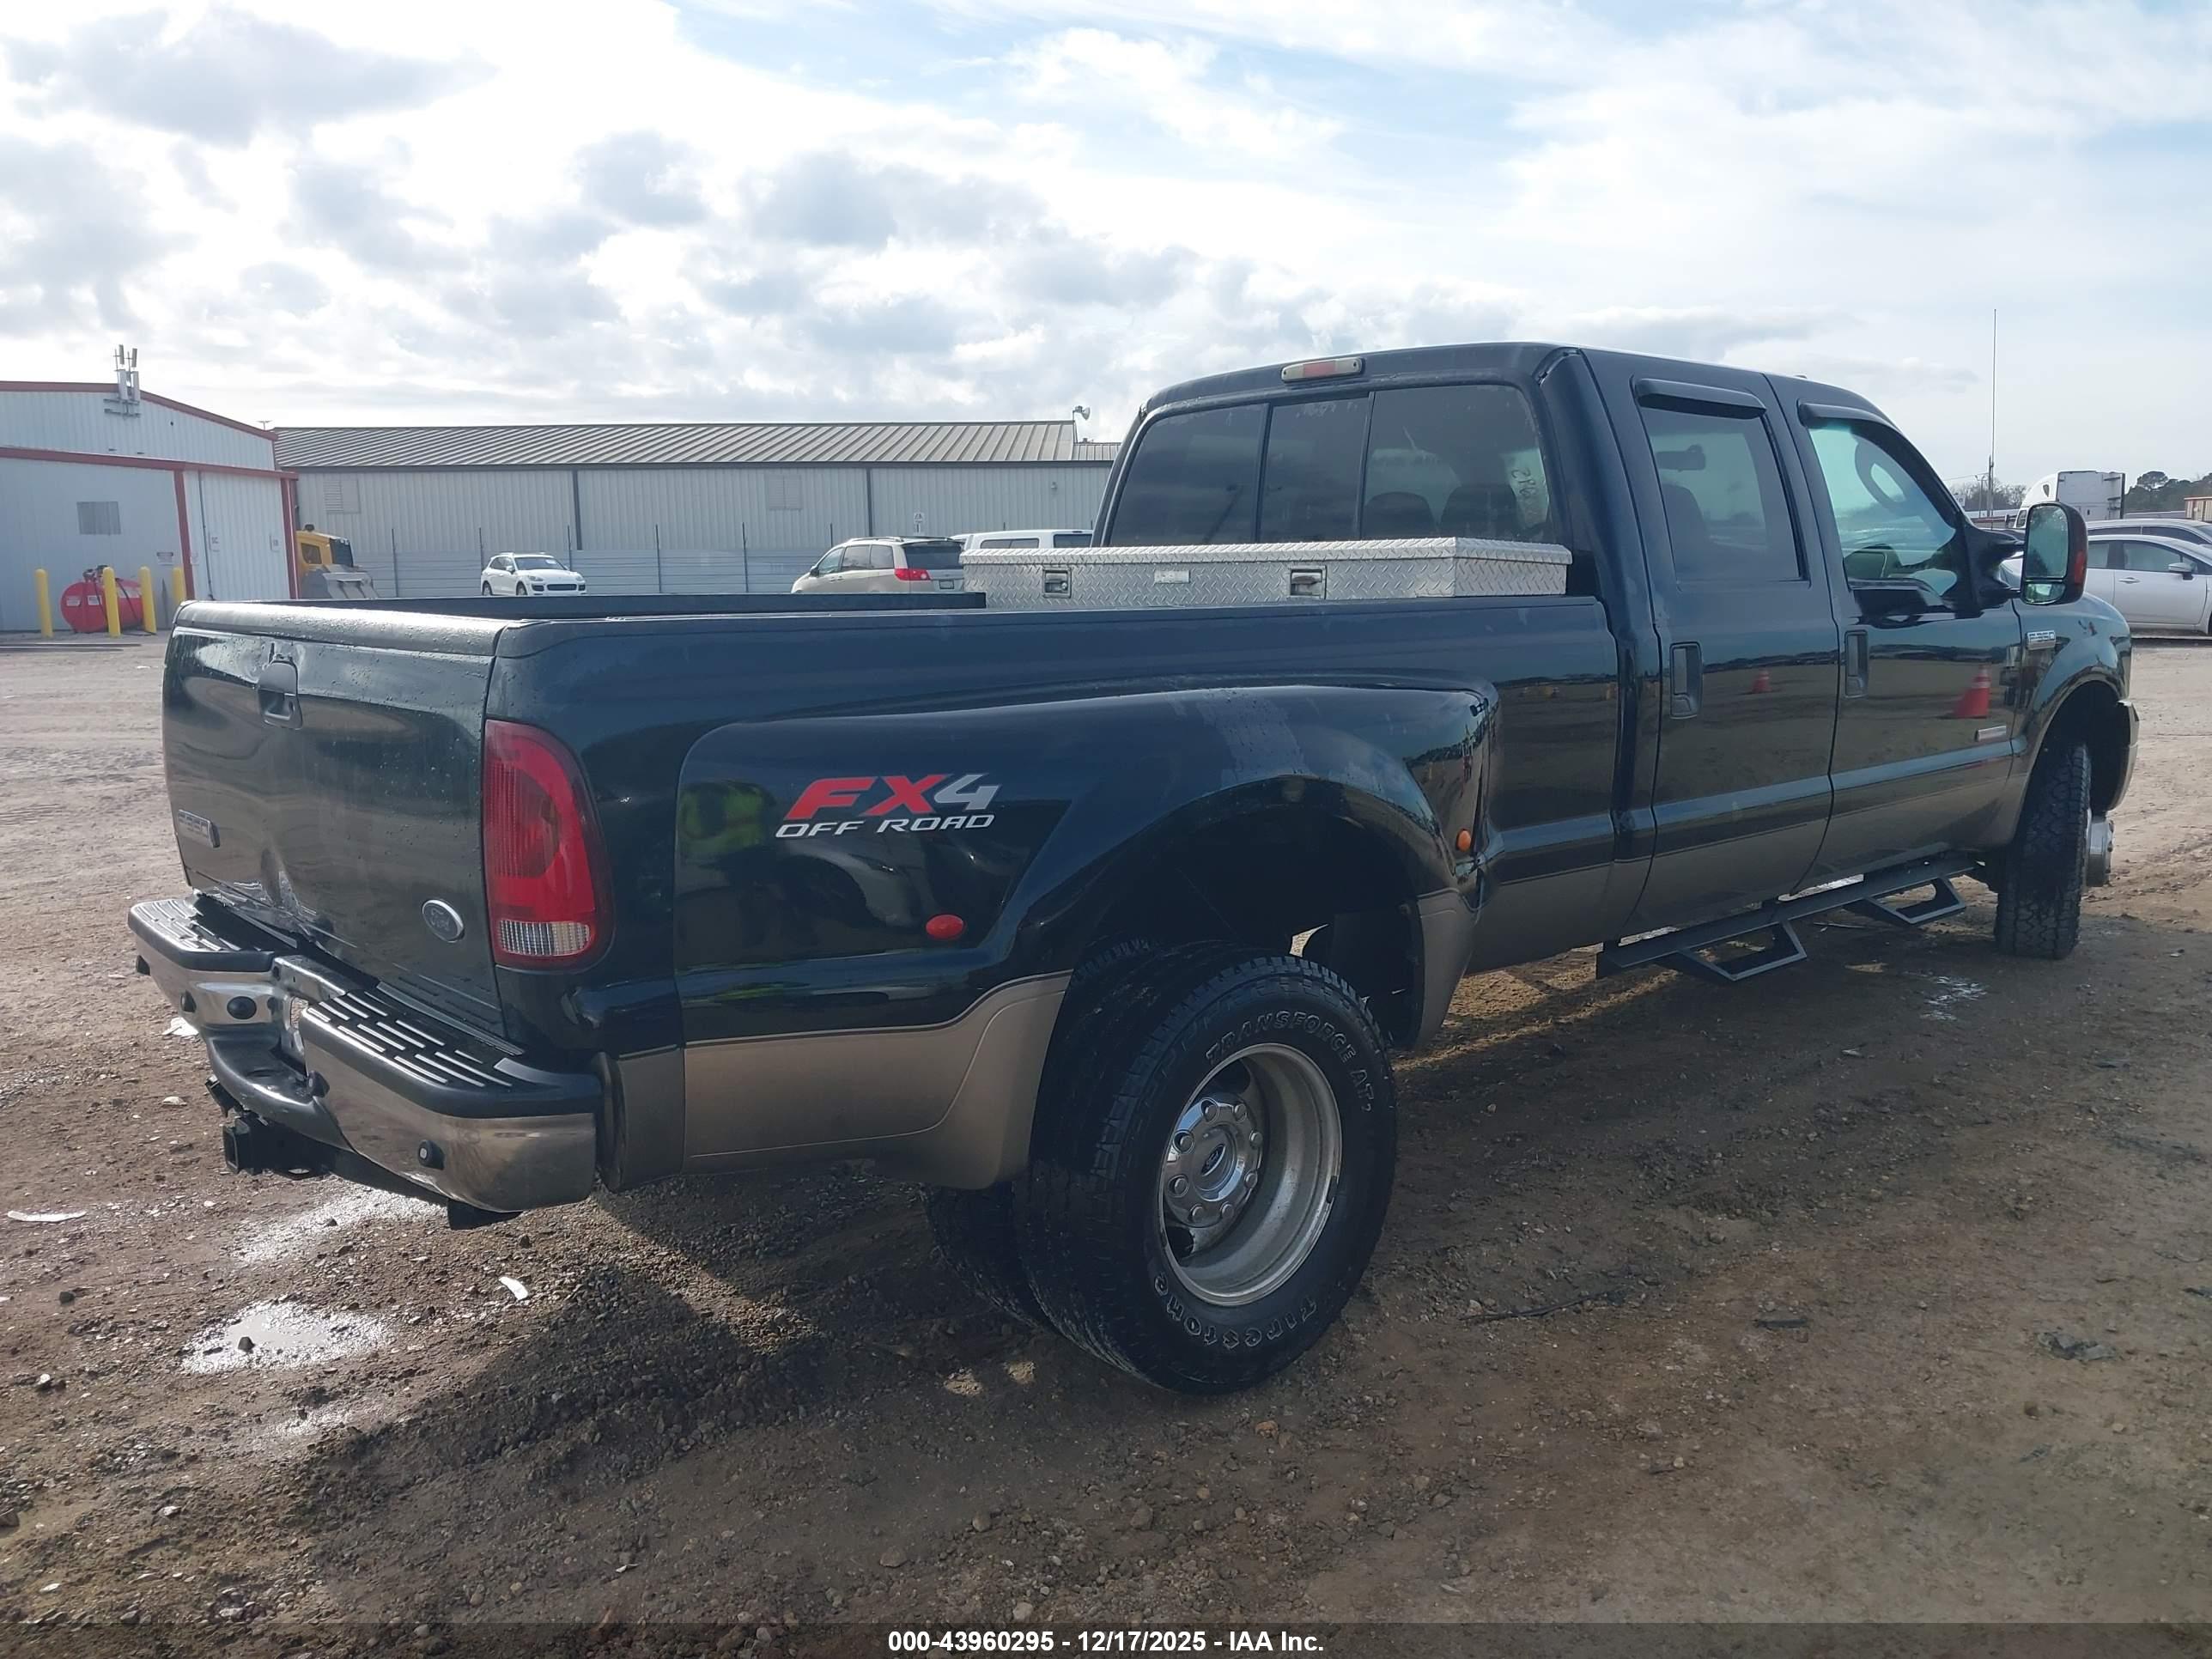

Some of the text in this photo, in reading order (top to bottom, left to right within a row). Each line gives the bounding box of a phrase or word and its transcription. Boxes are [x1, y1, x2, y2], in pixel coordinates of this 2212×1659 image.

[783, 773, 1001, 821] FX4
[775, 814, 995, 838] OFF ROAD
[1205, 1010, 1357, 1066] TRANSFORCE
